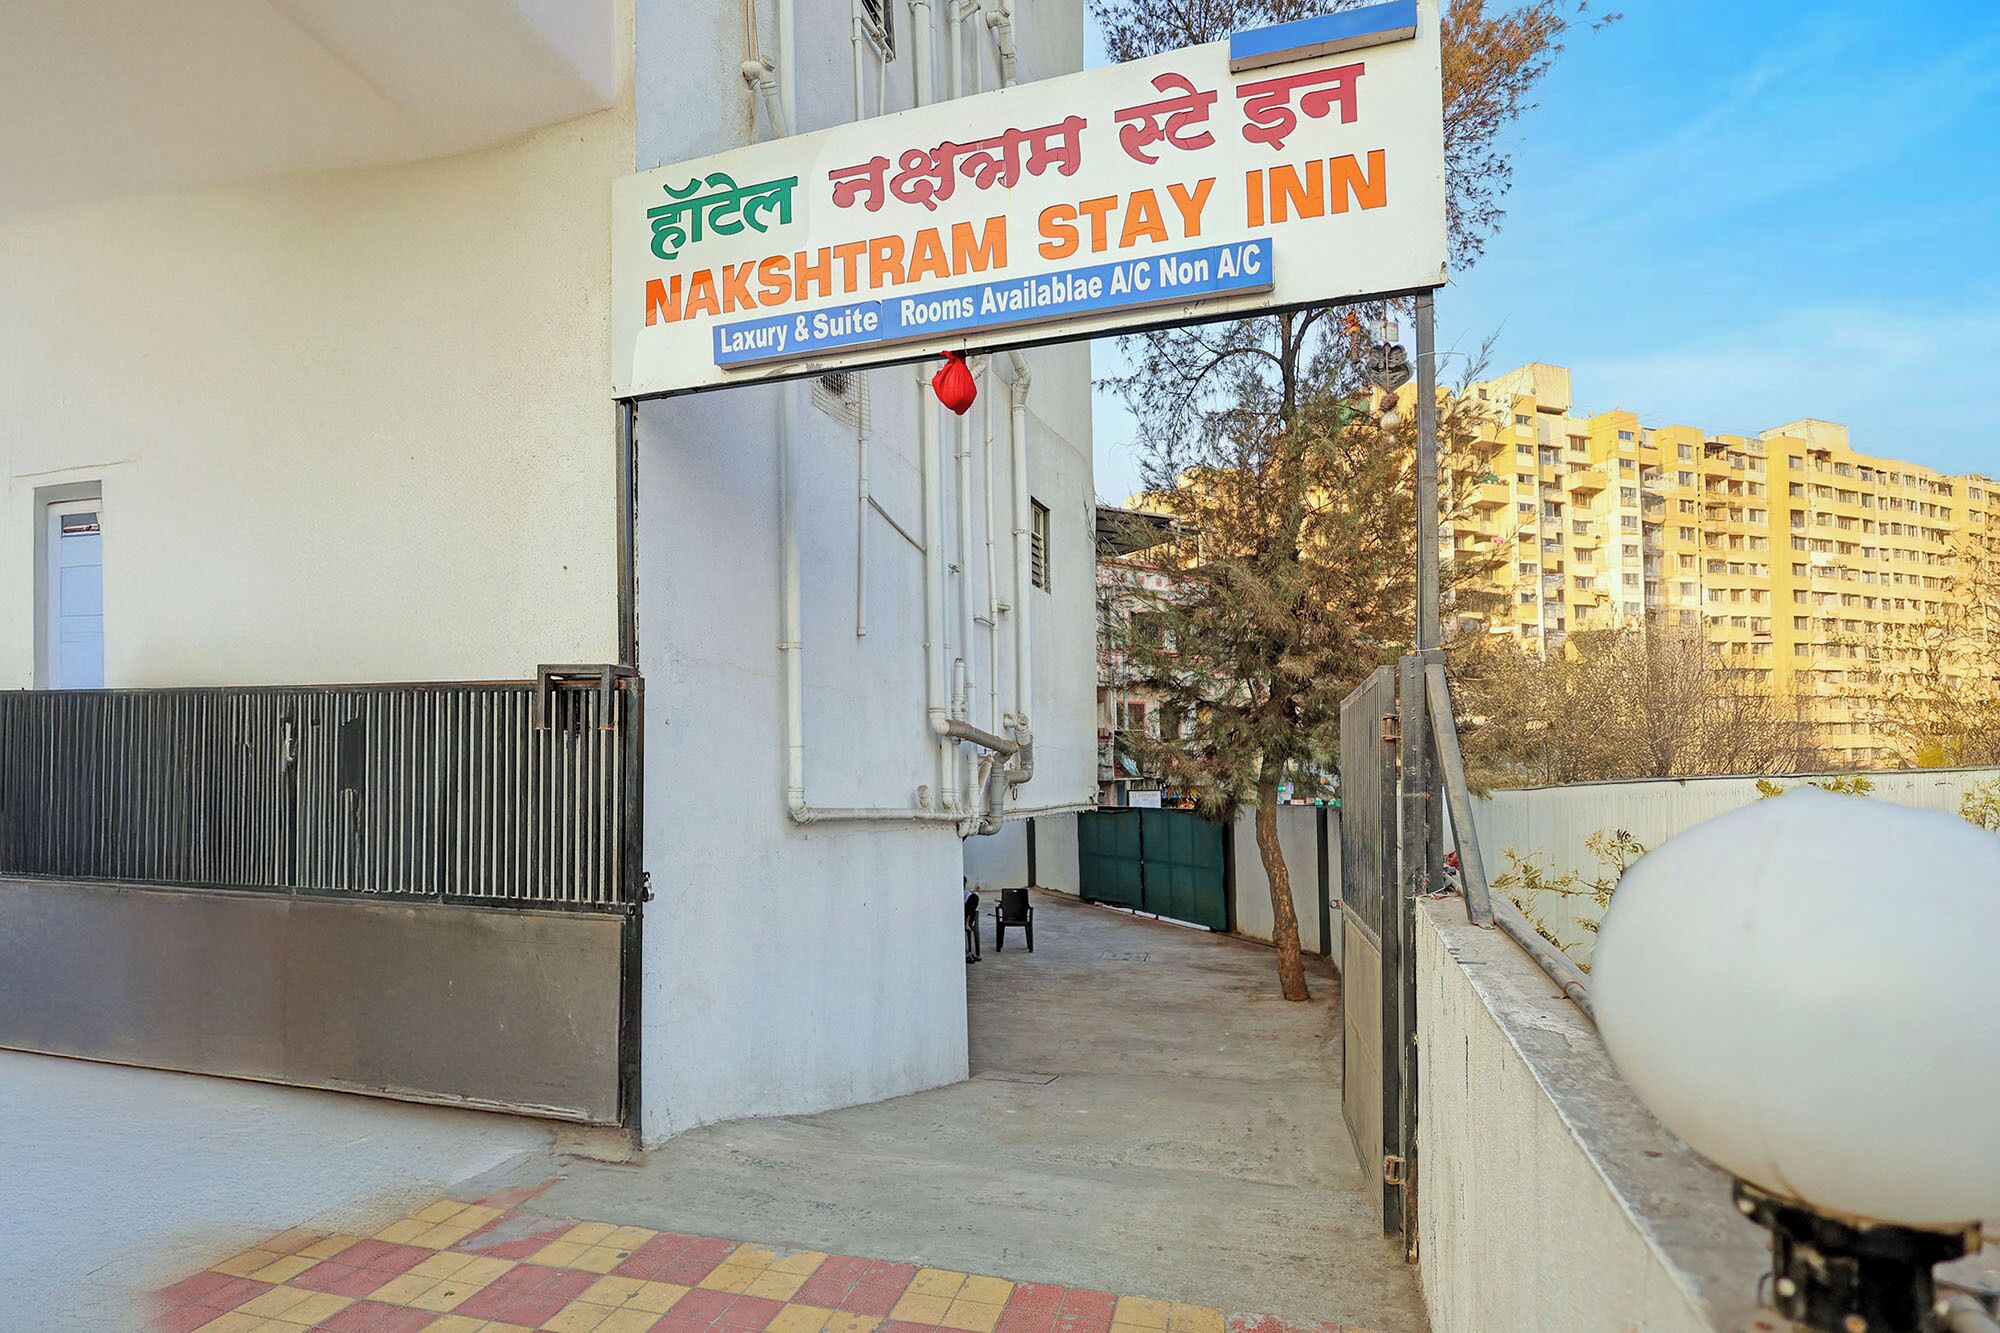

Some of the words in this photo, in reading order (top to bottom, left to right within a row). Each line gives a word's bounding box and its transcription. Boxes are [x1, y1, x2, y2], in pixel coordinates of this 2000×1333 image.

[645, 215, 1008, 327] NAKSHTRAM
[1038, 177, 1216, 260] STAY
[1246, 149, 1387, 228] INN
[647, 172, 798, 260] हॉटेल
[1114, 72, 1217, 165] स्टे
[1236, 62, 1365, 151] इन
[720, 323, 788, 354] Laxury
[794, 315, 810, 342] &
[813, 309, 878, 339] Suite
[901, 293, 975, 328] Rooms
[980, 274, 1102, 315] Availablae
[1110, 261, 1151, 295] A/C
[1159, 257, 1209, 287] Non
[1217, 243, 1262, 279] A/C
